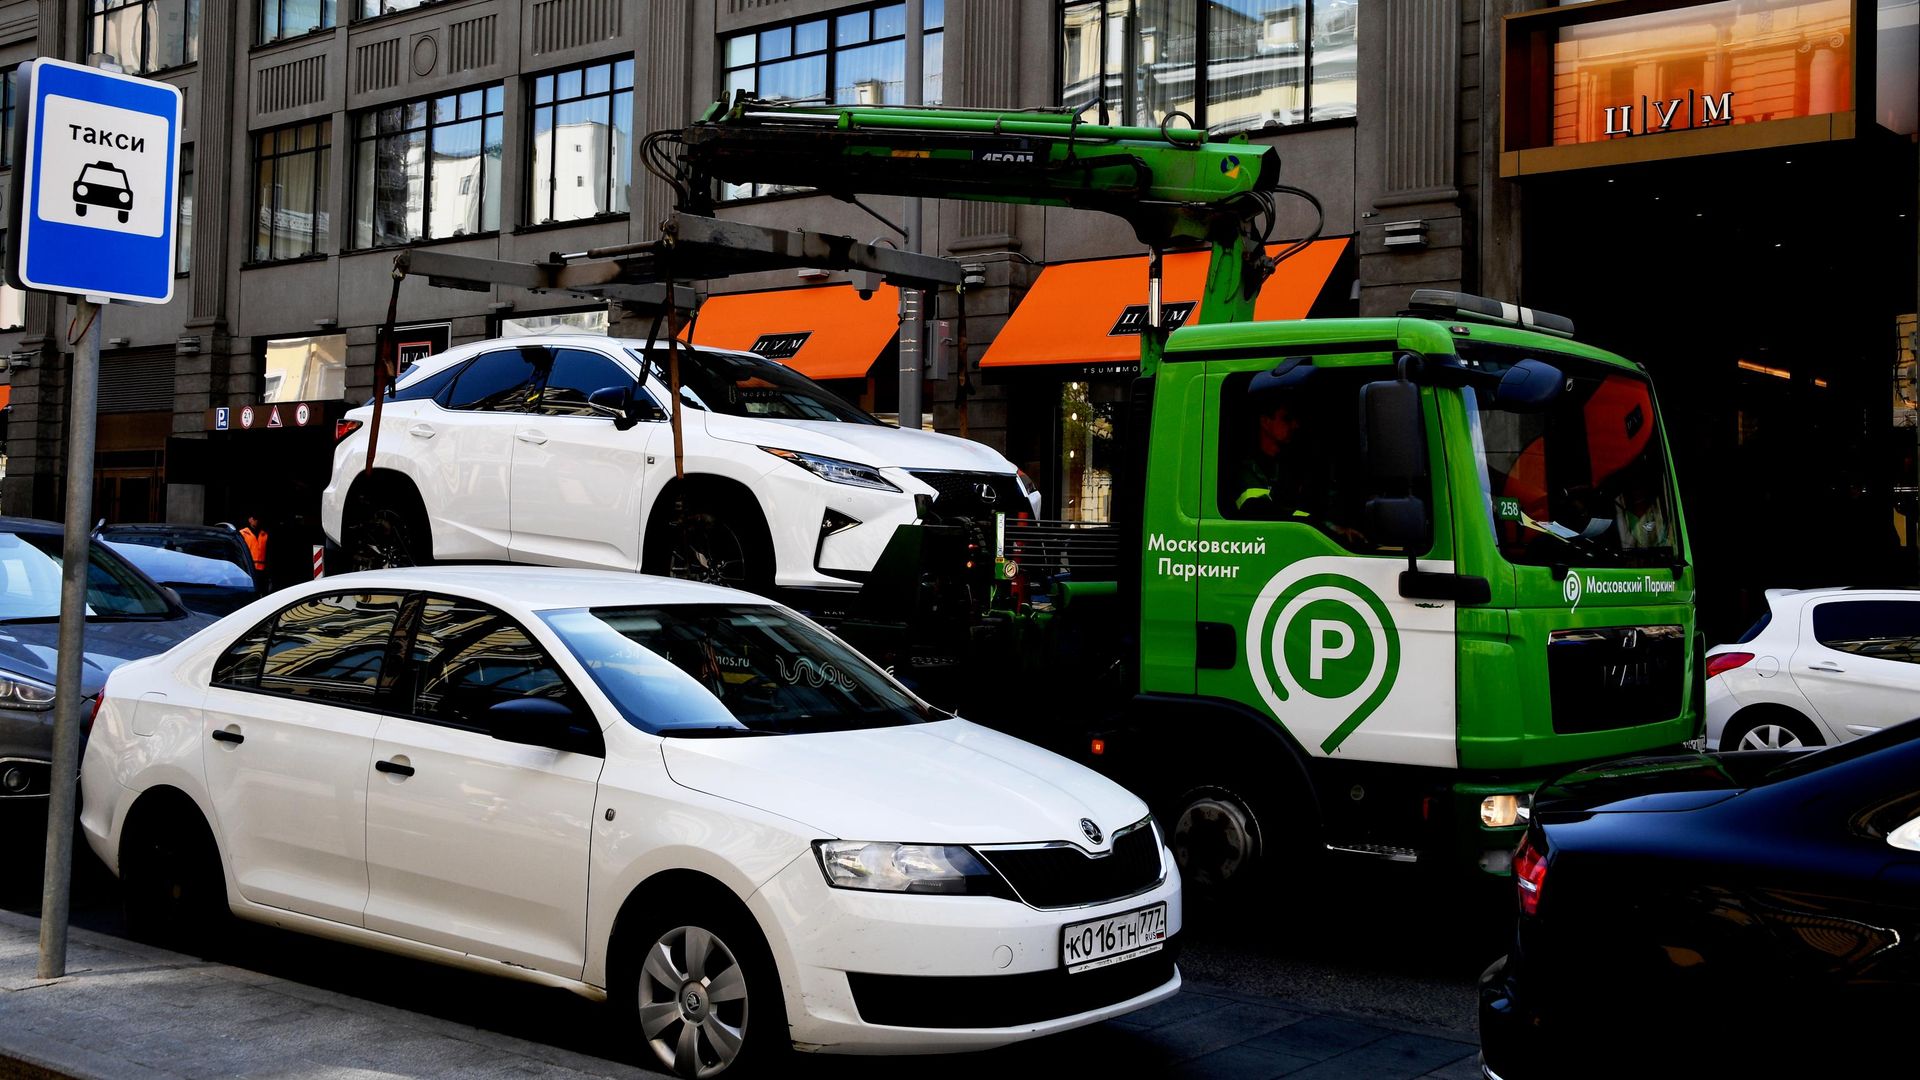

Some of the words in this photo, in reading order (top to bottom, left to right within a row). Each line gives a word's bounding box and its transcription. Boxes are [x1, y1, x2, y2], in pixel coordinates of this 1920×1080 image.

[69, 124, 144, 153] такси
[1501, 502, 1519, 516] 258
[1148, 533, 1266, 555] Московский
[1158, 557, 1240, 582] Паркинг
[1586, 576, 1642, 593] Московский
[1645, 576, 1675, 597] Паркинг
[1140, 908, 1162, 934] 777
[1145, 932, 1156, 942] RUS
